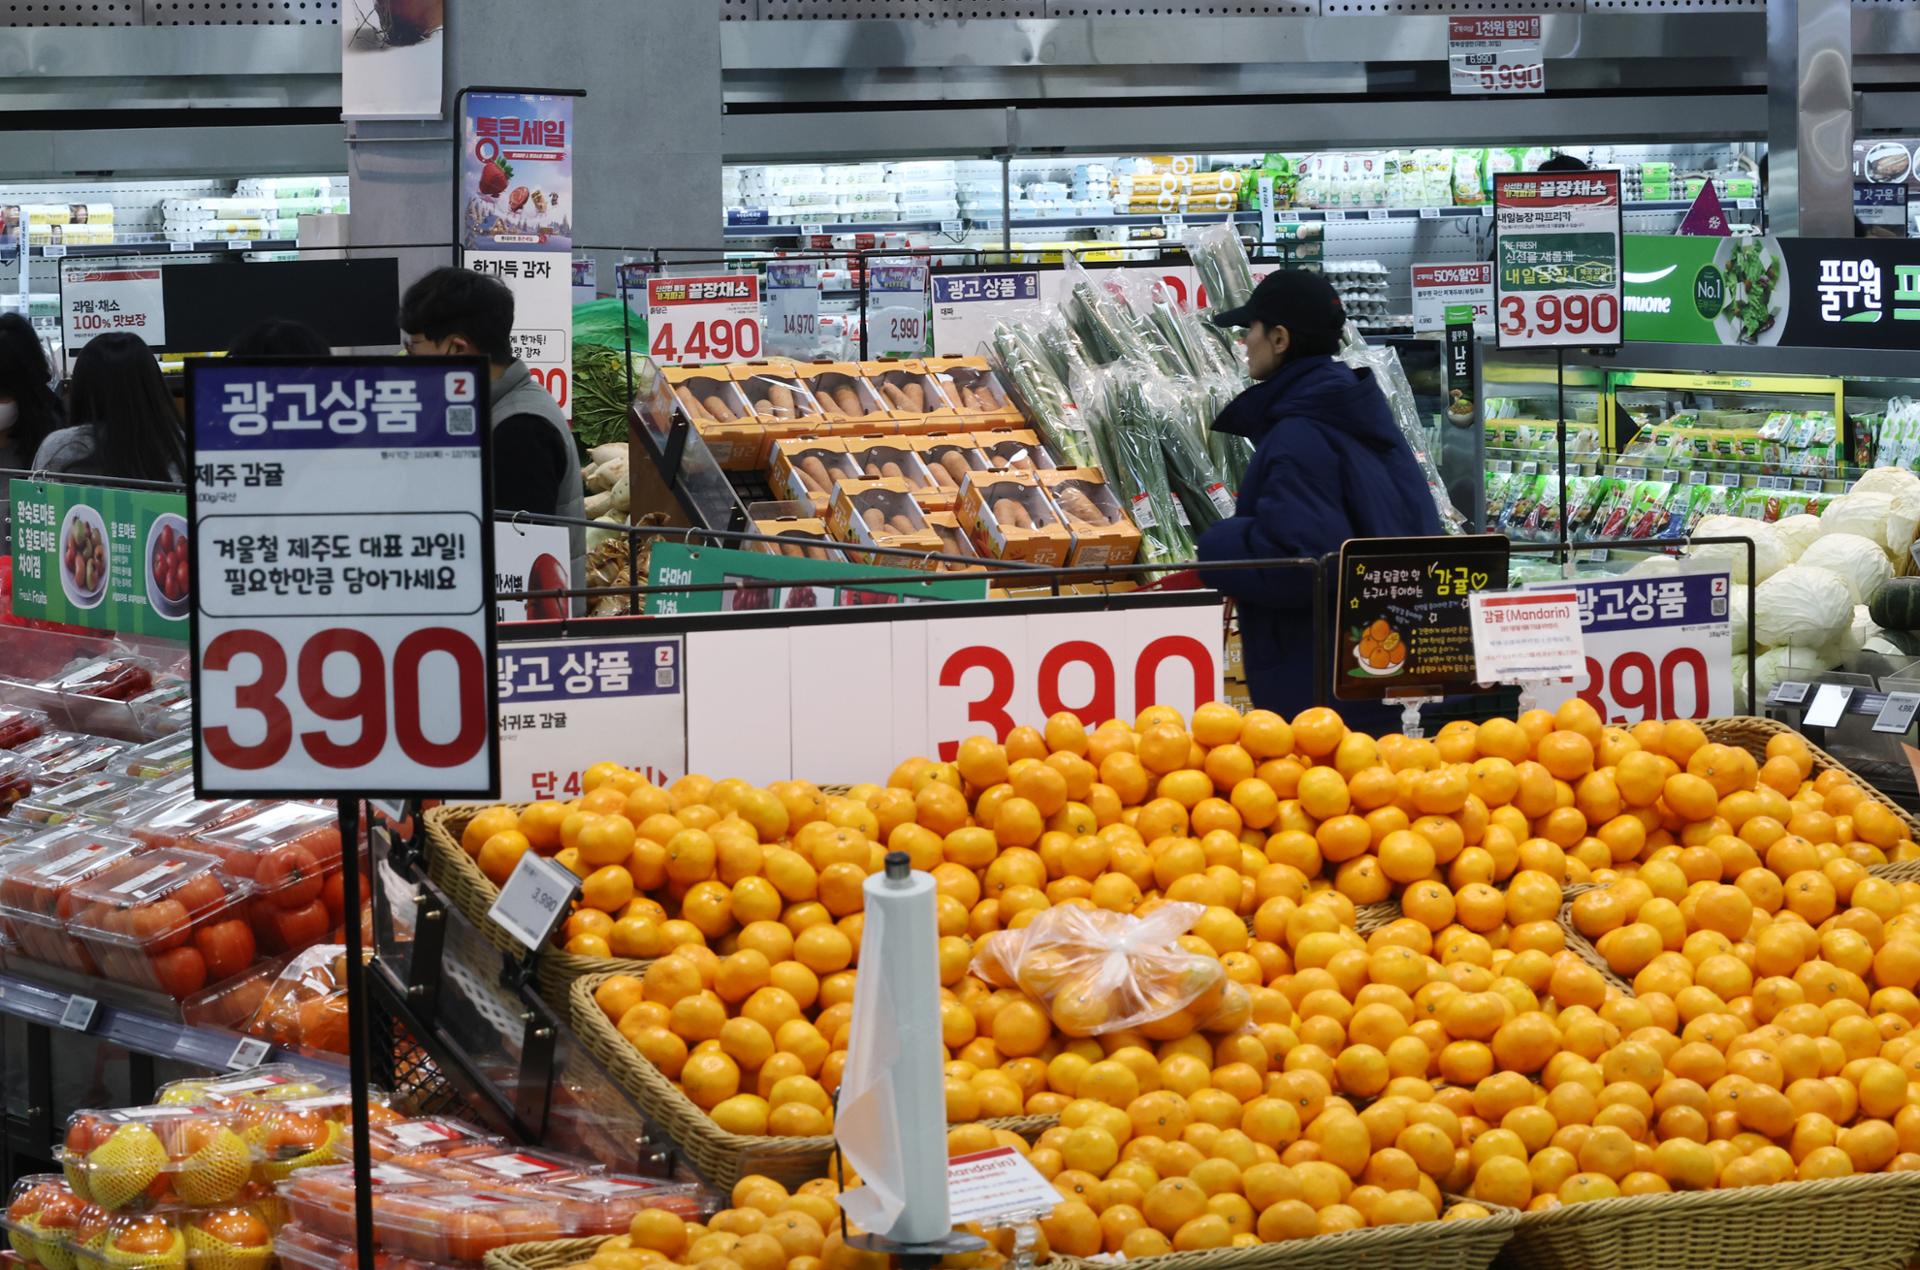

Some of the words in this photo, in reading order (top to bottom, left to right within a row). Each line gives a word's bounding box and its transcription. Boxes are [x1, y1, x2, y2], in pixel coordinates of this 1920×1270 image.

[1475, 20, 1504, 36] 1천원
[1507, 20, 1529, 36] 할인
[1480, 64, 1542, 90] 5,990
[475, 117, 565, 164] 통큰세일
[1540, 181, 1607, 197] 끝장채소
[1498, 212, 1534, 223] 내일농장
[1535, 211, 1571, 222] 파프리카
[522, 261, 551, 279] 감자
[689, 282, 749, 299] 끝장채소
[948, 280, 981, 300] 광고
[983, 279, 1017, 299] 상품
[1697, 279, 1720, 299] No.1
[1818, 259, 1883, 323] 풀무원
[72, 300, 120, 313] 과일·채소
[1500, 294, 1618, 338] 3,990
[1623, 296, 1671, 314] muone
[72, 315, 111, 330] 100%
[113, 314, 146, 327] 맛보장
[891, 318, 919, 341] 2,990
[520, 335, 547, 345] 한가득!
[651, 318, 760, 363] 4,490
[525, 347, 541, 358] 감자
[222, 380, 422, 435] 광고상품
[195, 464, 237, 487] 제주
[241, 463, 284, 486] 감귤
[196, 492, 236, 503] 00g/국산
[18, 501, 55, 525] 완숙토마토
[26, 528, 56, 552] 찰토마토
[213, 535, 278, 563] 겨울철
[288, 535, 350, 562] 제주도
[360, 534, 402, 558] 대표
[411, 534, 465, 558] 과일!
[19, 554, 40, 578] 차이점
[225, 568, 334, 595] 필요한만큼
[343, 567, 456, 594] 담아가세요
[1435, 567, 1469, 595] 감귤
[1483, 610, 1504, 624] 감귤
[1506, 606, 1570, 622] (Mandarin)
[1577, 582, 1687, 626] 광고상품
[559, 651, 632, 694] 상품
[202, 627, 485, 770] 390
[938, 635, 1215, 763] 390
[498, 714, 536, 731] 서귀포
[539, 712, 567, 729] 감귤
[532, 771, 557, 800] 단
